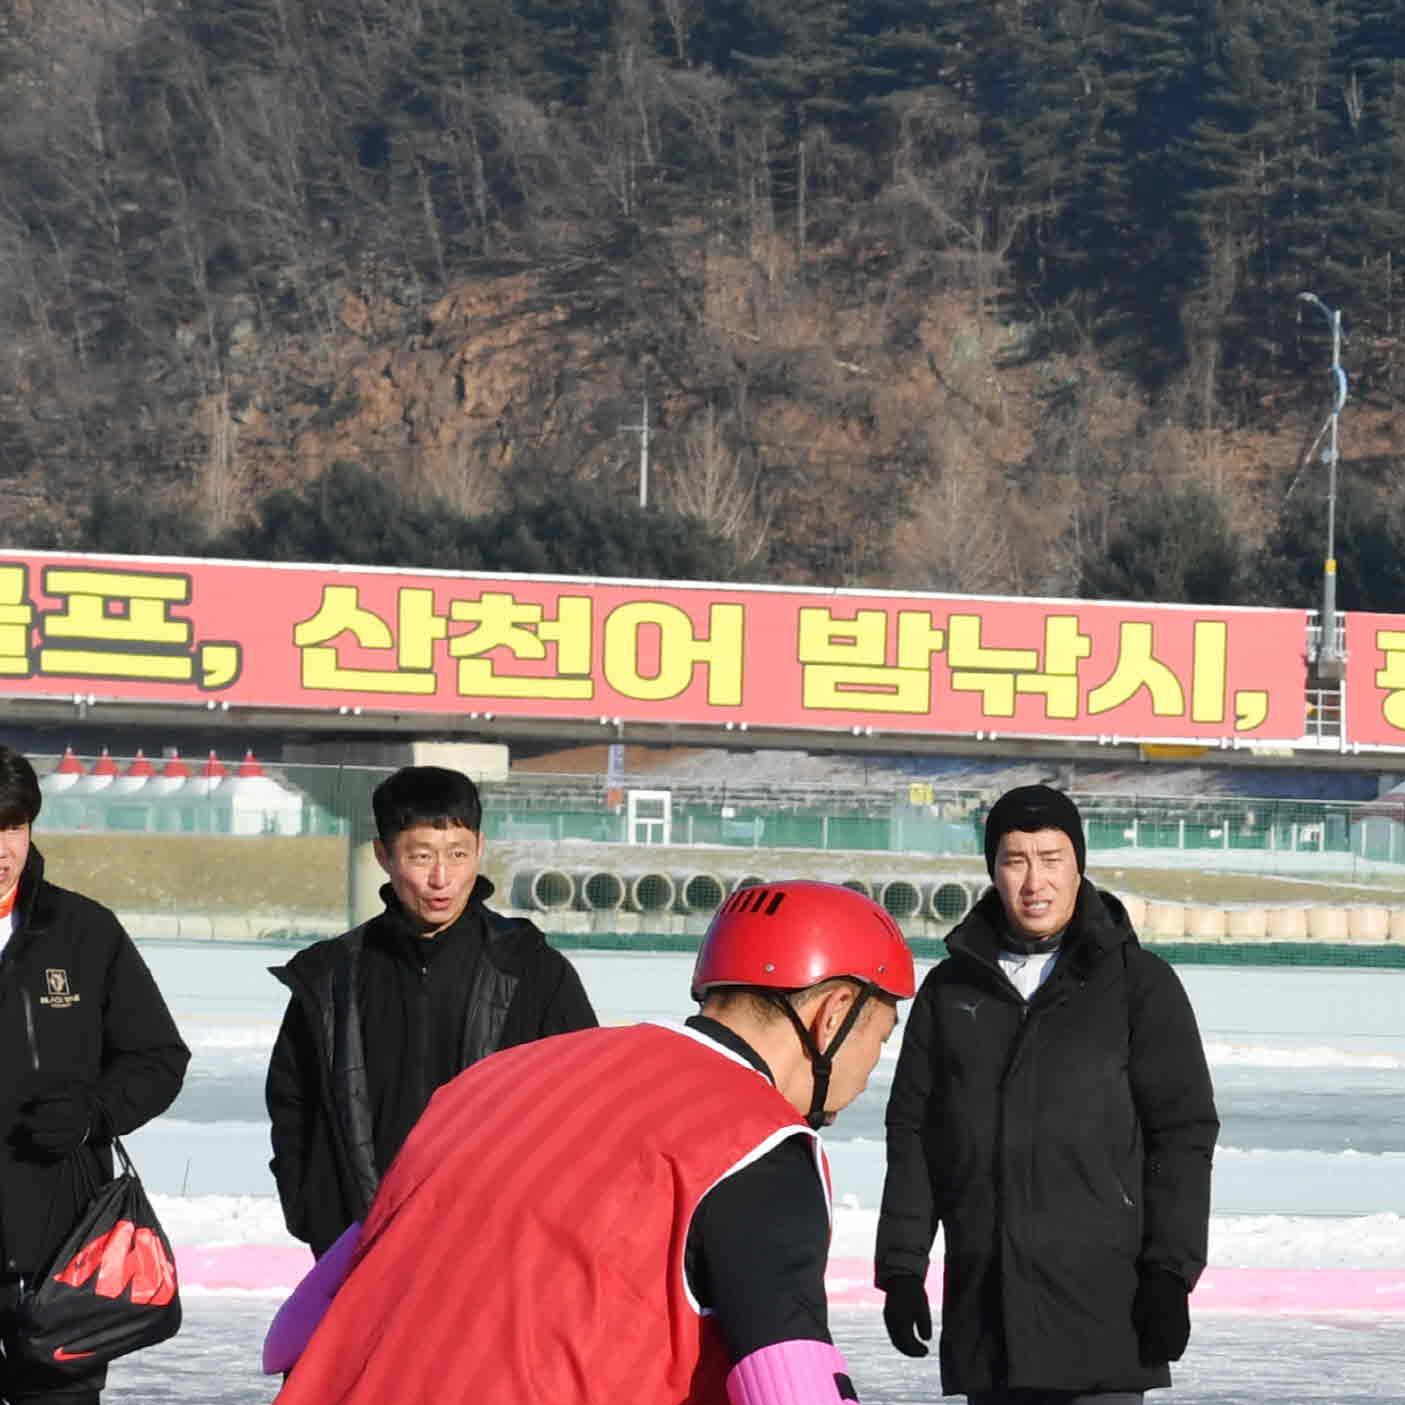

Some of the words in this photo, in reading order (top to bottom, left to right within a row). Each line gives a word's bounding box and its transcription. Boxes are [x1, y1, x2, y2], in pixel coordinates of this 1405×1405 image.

[0, 562, 243, 691] 프,
[293, 584, 745, 707] 산천어
[797, 606, 1269, 732] 밤낚시,
